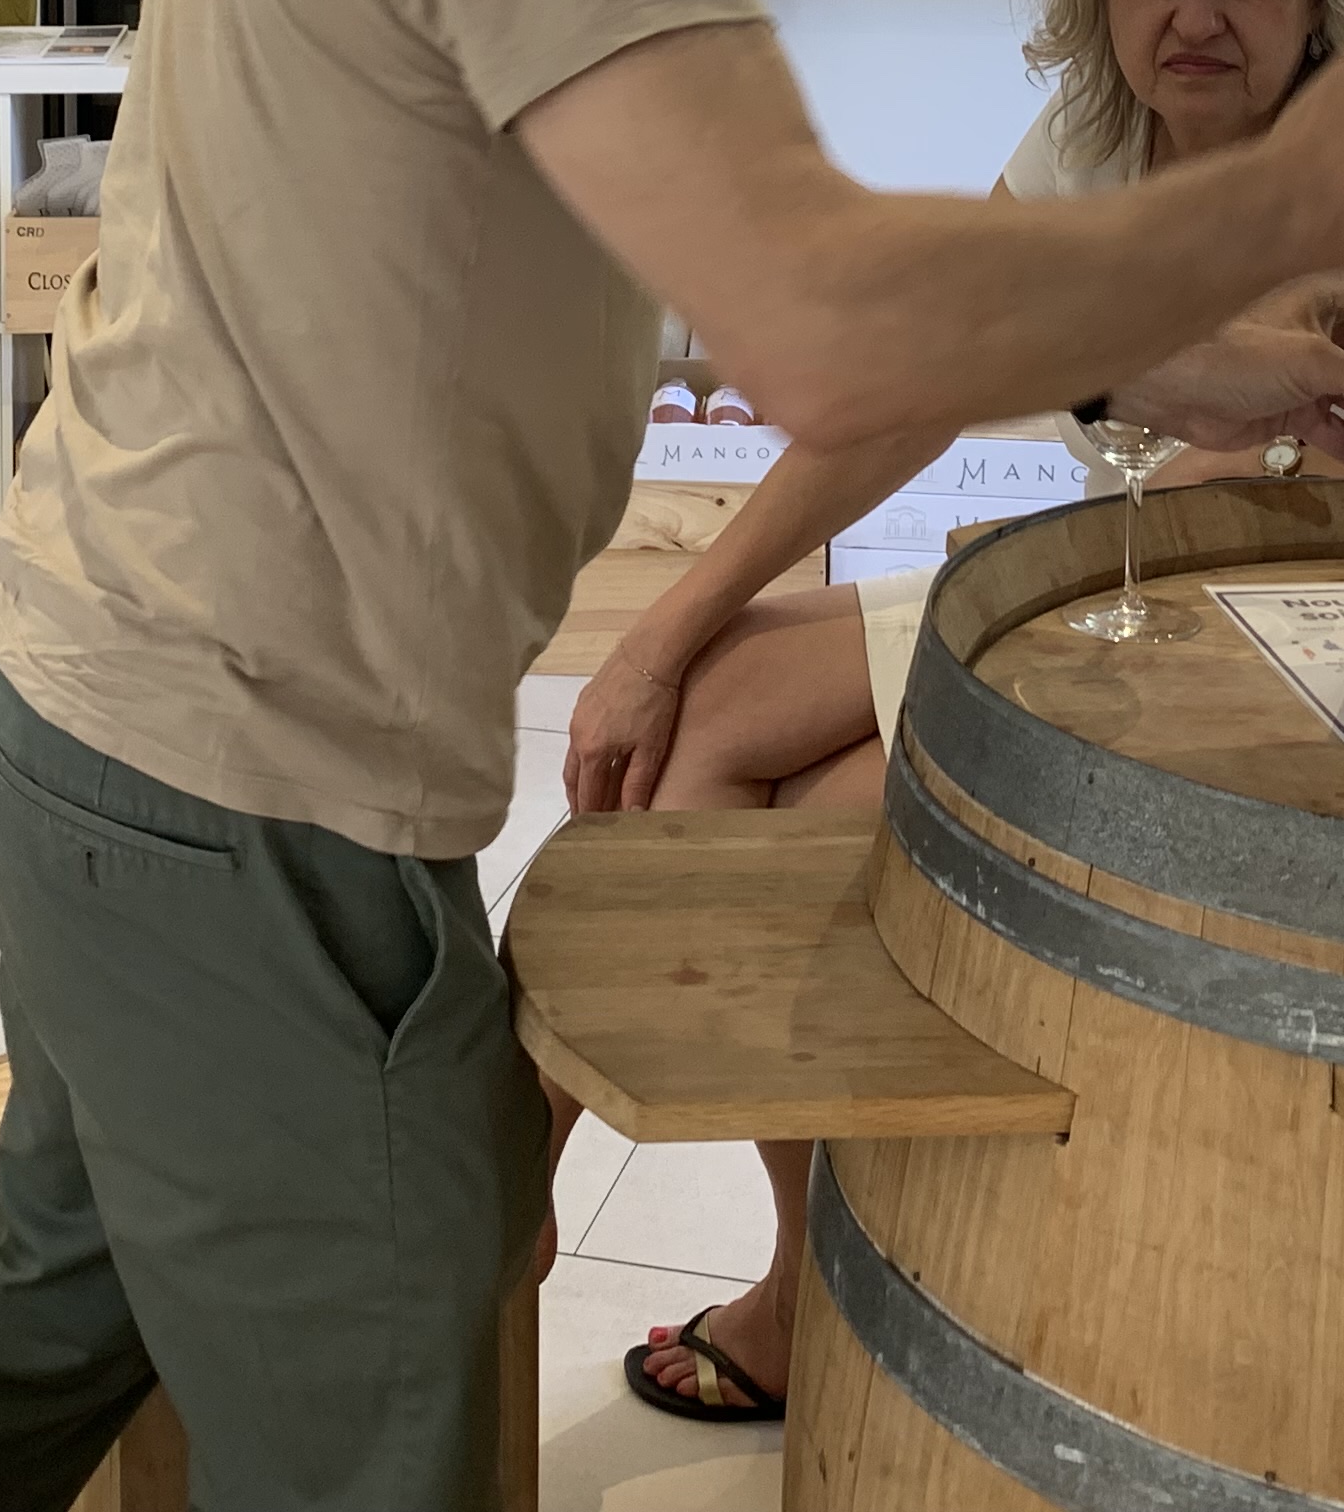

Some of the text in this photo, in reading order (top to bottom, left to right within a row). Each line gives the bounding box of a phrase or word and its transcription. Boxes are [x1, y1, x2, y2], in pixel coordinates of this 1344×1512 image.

[16, 226, 45, 238] CRD
[661, 444, 787, 468] MANGO
[958, 457, 1091, 491] MANG
